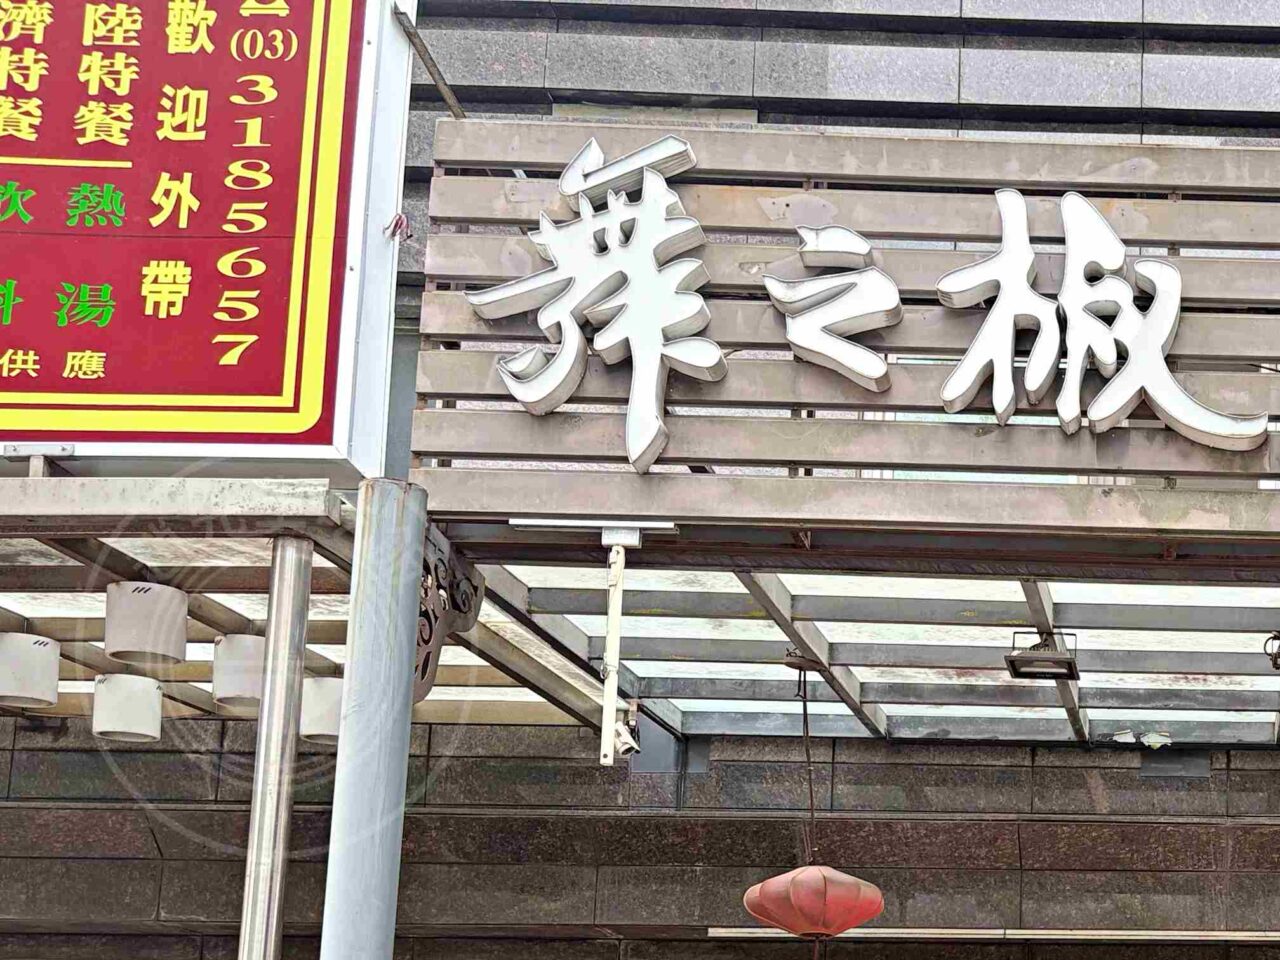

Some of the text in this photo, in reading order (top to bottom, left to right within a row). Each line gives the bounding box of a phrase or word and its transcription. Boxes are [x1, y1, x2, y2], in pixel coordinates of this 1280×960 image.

[74, 3, 143, 146] 陸特餐
[141, 0, 218, 319] 歡迎外帶
[55, 182, 126, 327] 熱湯
[464, 134, 1269, 474] 舞之椒
